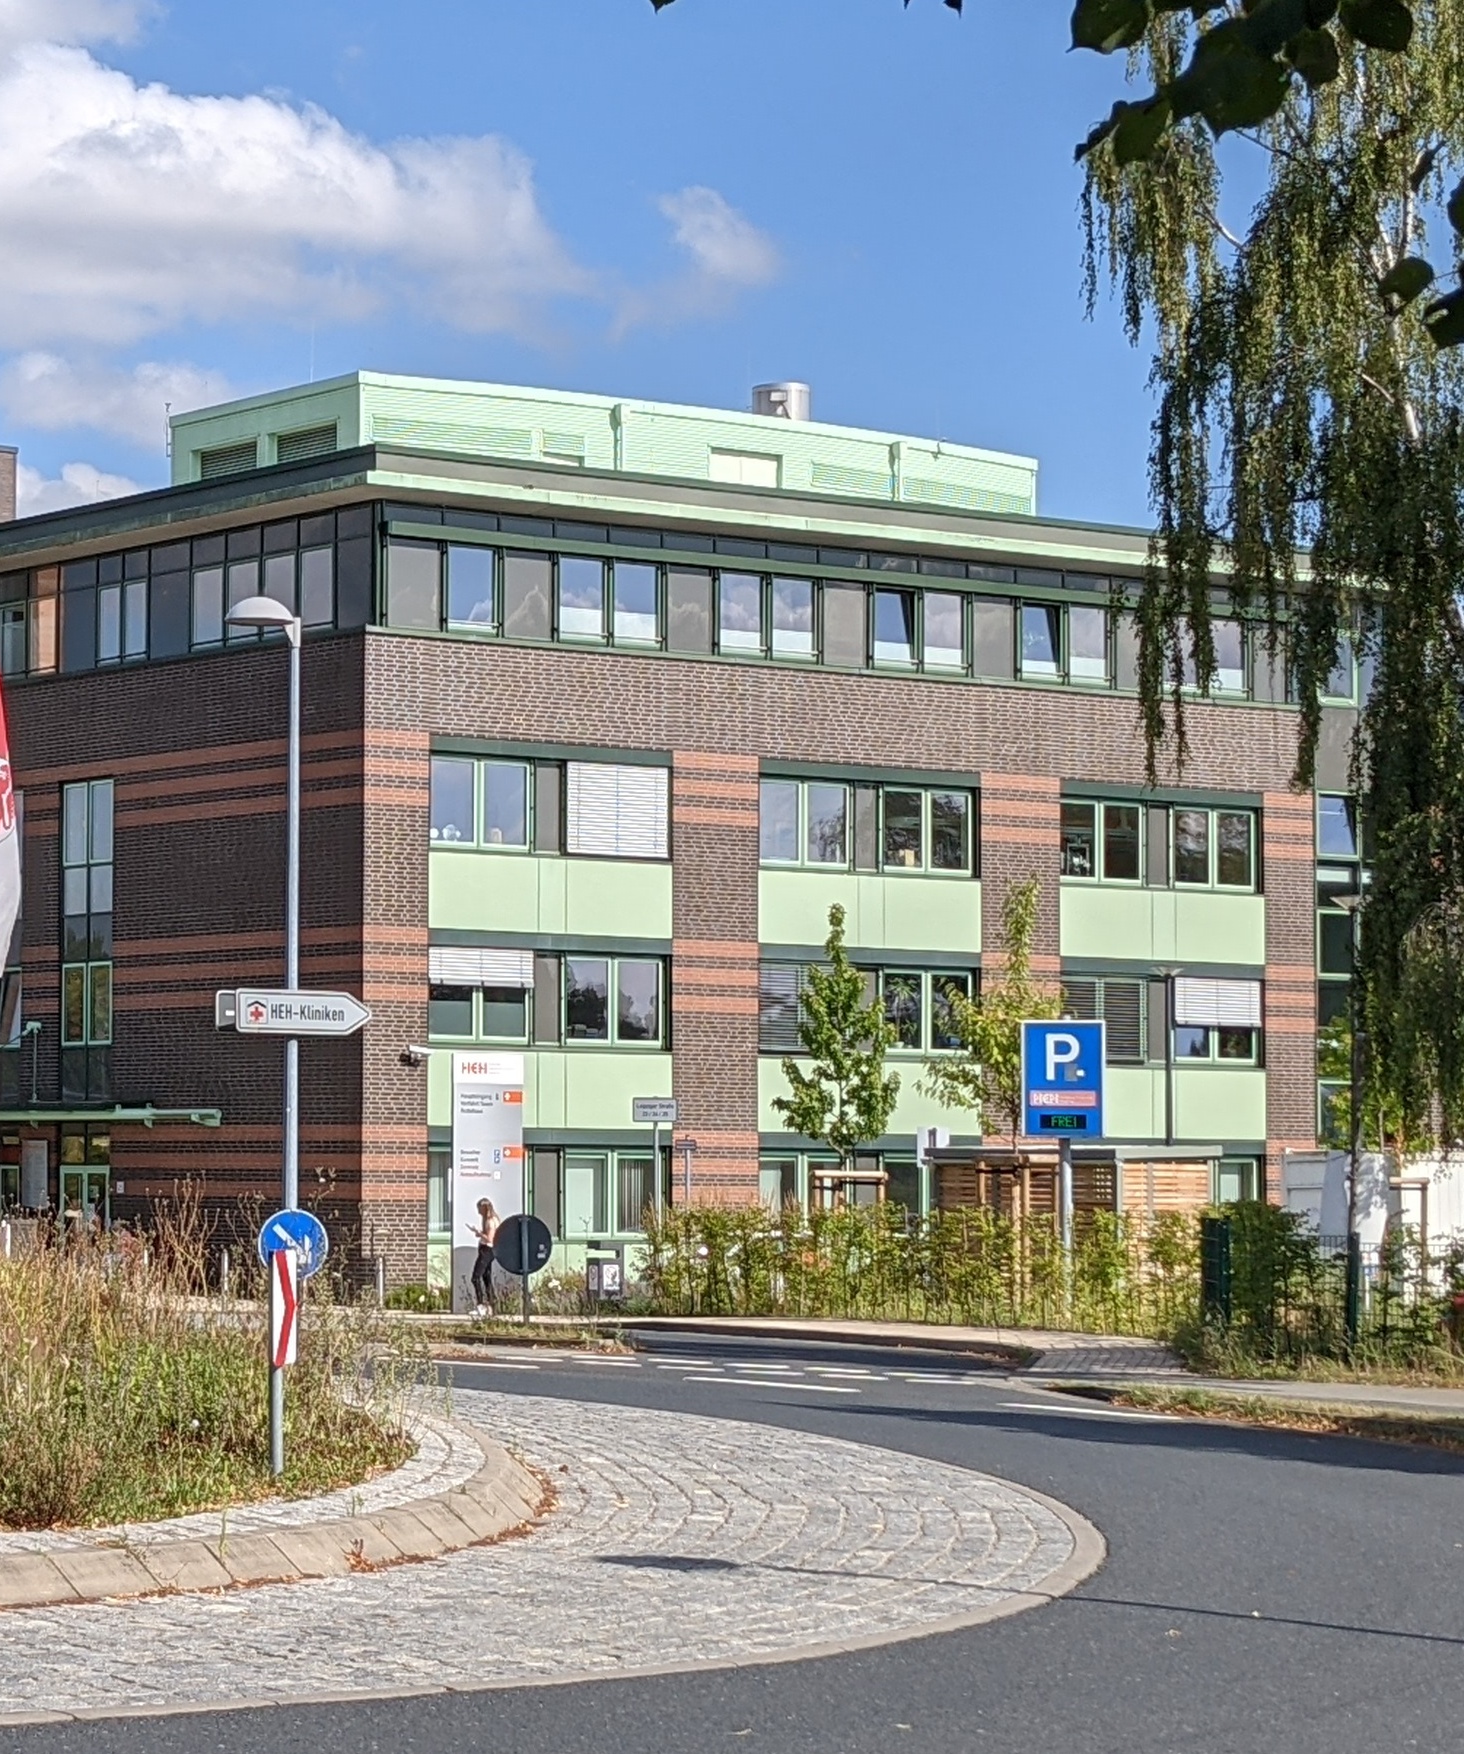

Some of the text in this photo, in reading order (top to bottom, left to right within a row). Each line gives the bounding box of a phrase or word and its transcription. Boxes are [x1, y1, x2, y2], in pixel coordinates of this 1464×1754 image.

[270, 1003, 345, 1022] HEH-Kliniken
[1045, 1032, 1081, 1081] P
[461, 1061, 488, 1075] HEH
[1051, 1115, 1077, 1128] FREI
